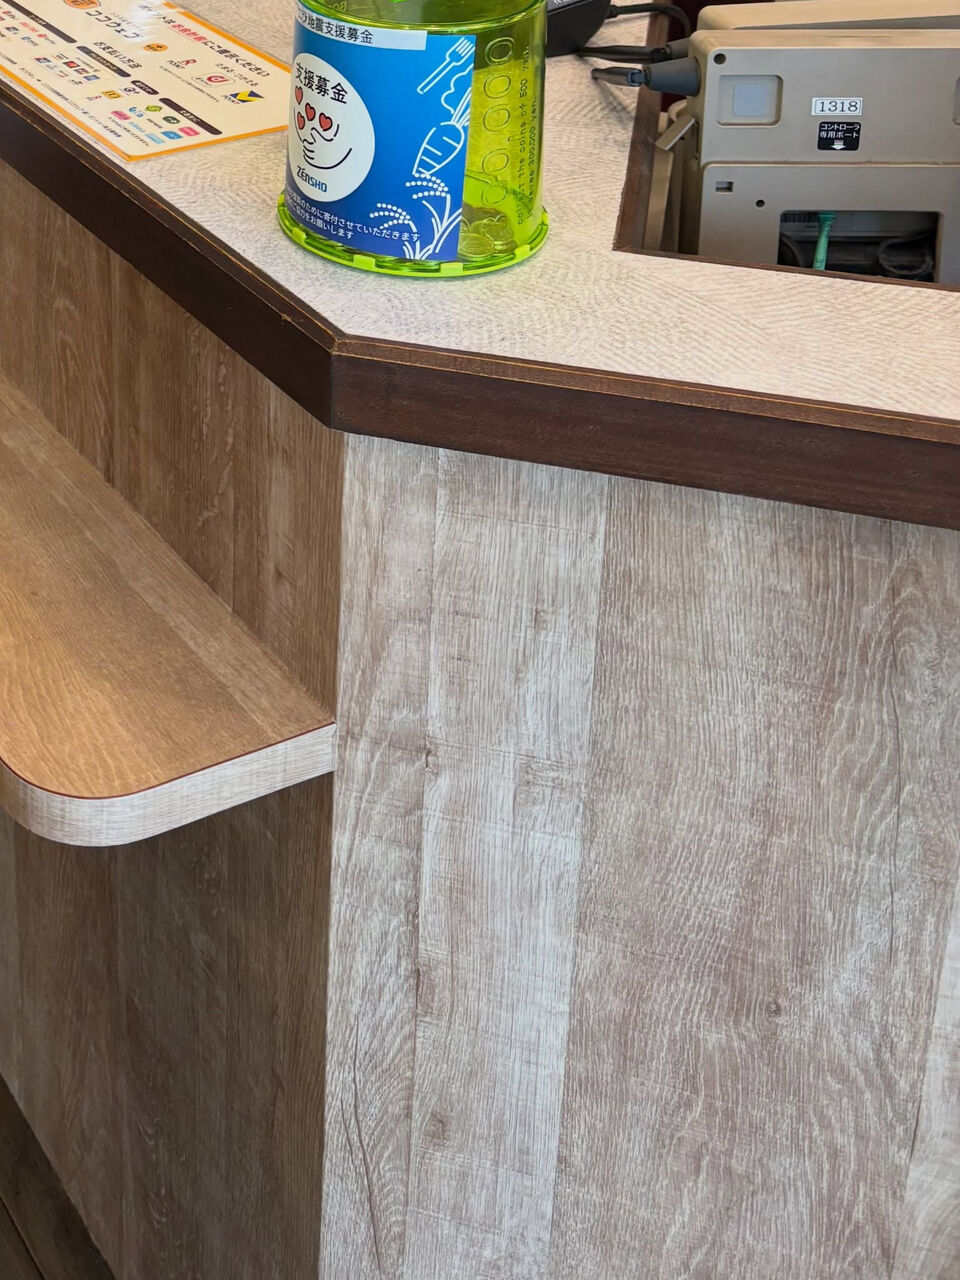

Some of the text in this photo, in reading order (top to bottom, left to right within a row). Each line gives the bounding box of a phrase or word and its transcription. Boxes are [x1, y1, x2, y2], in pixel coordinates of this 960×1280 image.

[296, 63, 348, 105] 支援募金
[819, 100, 858, 113] 1318
[821, 123, 860, 131] コントローラ
[820, 131, 859, 139] 専用ポート
